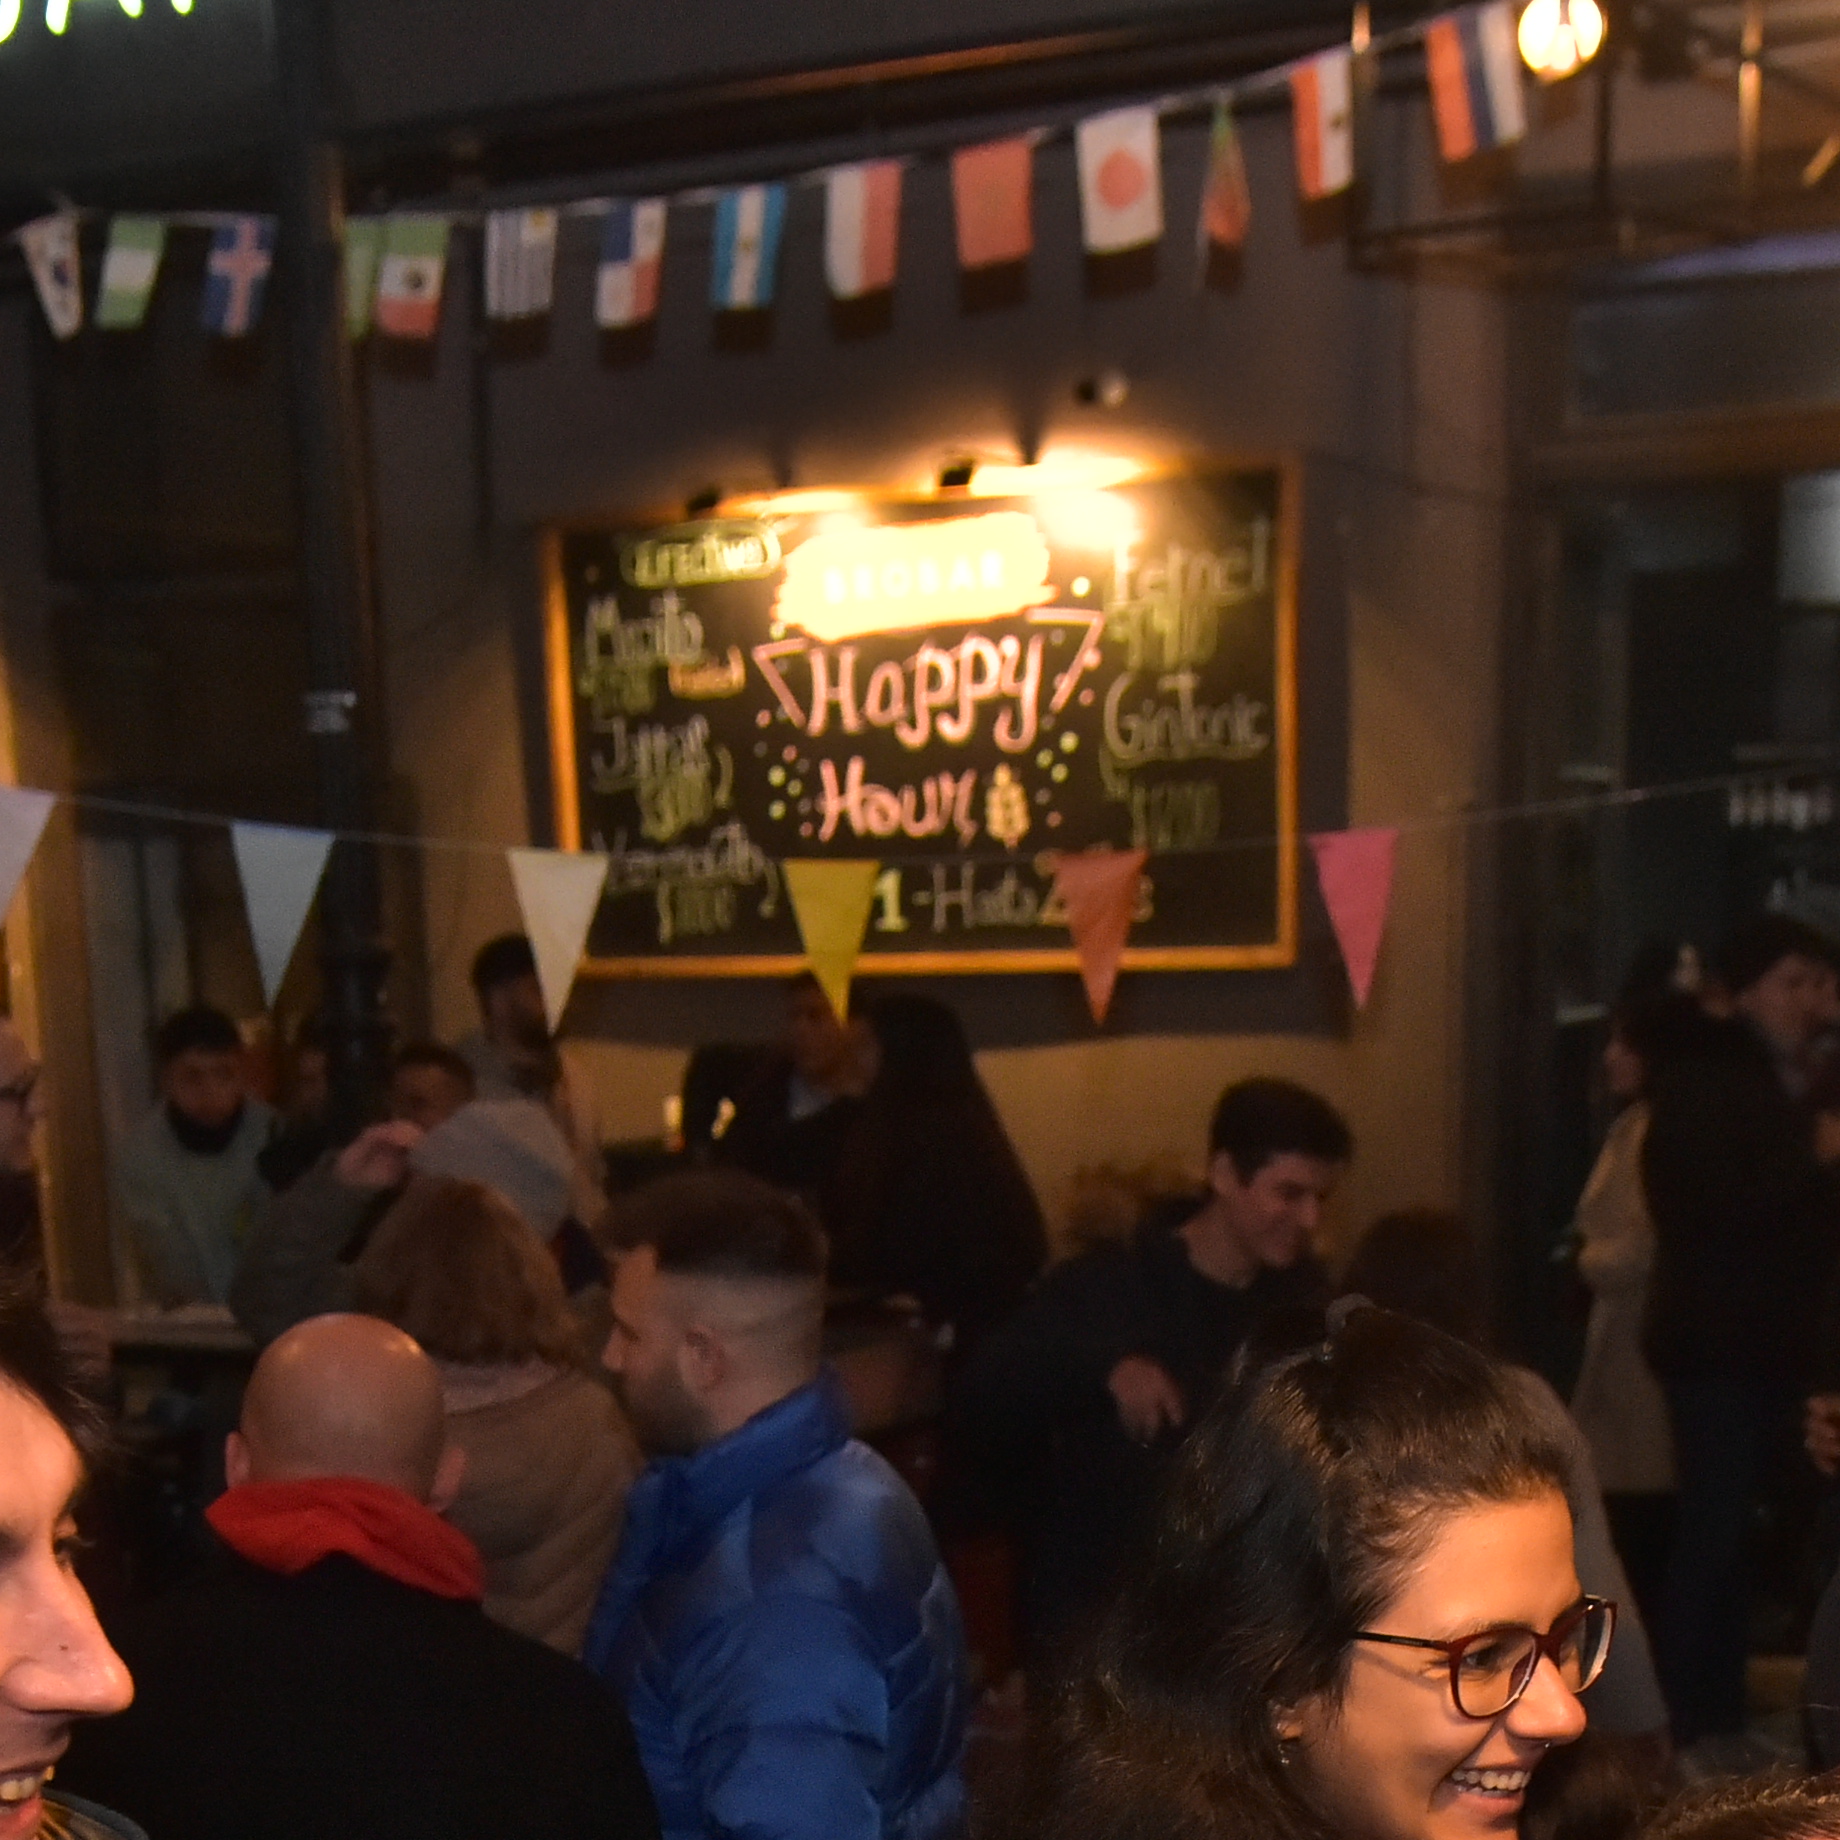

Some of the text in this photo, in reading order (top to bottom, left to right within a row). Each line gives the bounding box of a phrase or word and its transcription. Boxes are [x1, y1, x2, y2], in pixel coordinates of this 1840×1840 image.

[823, 549, 1003, 604] BROBAR
[806, 630, 1046, 755] Happy
[818, 755, 979, 849] Hour
